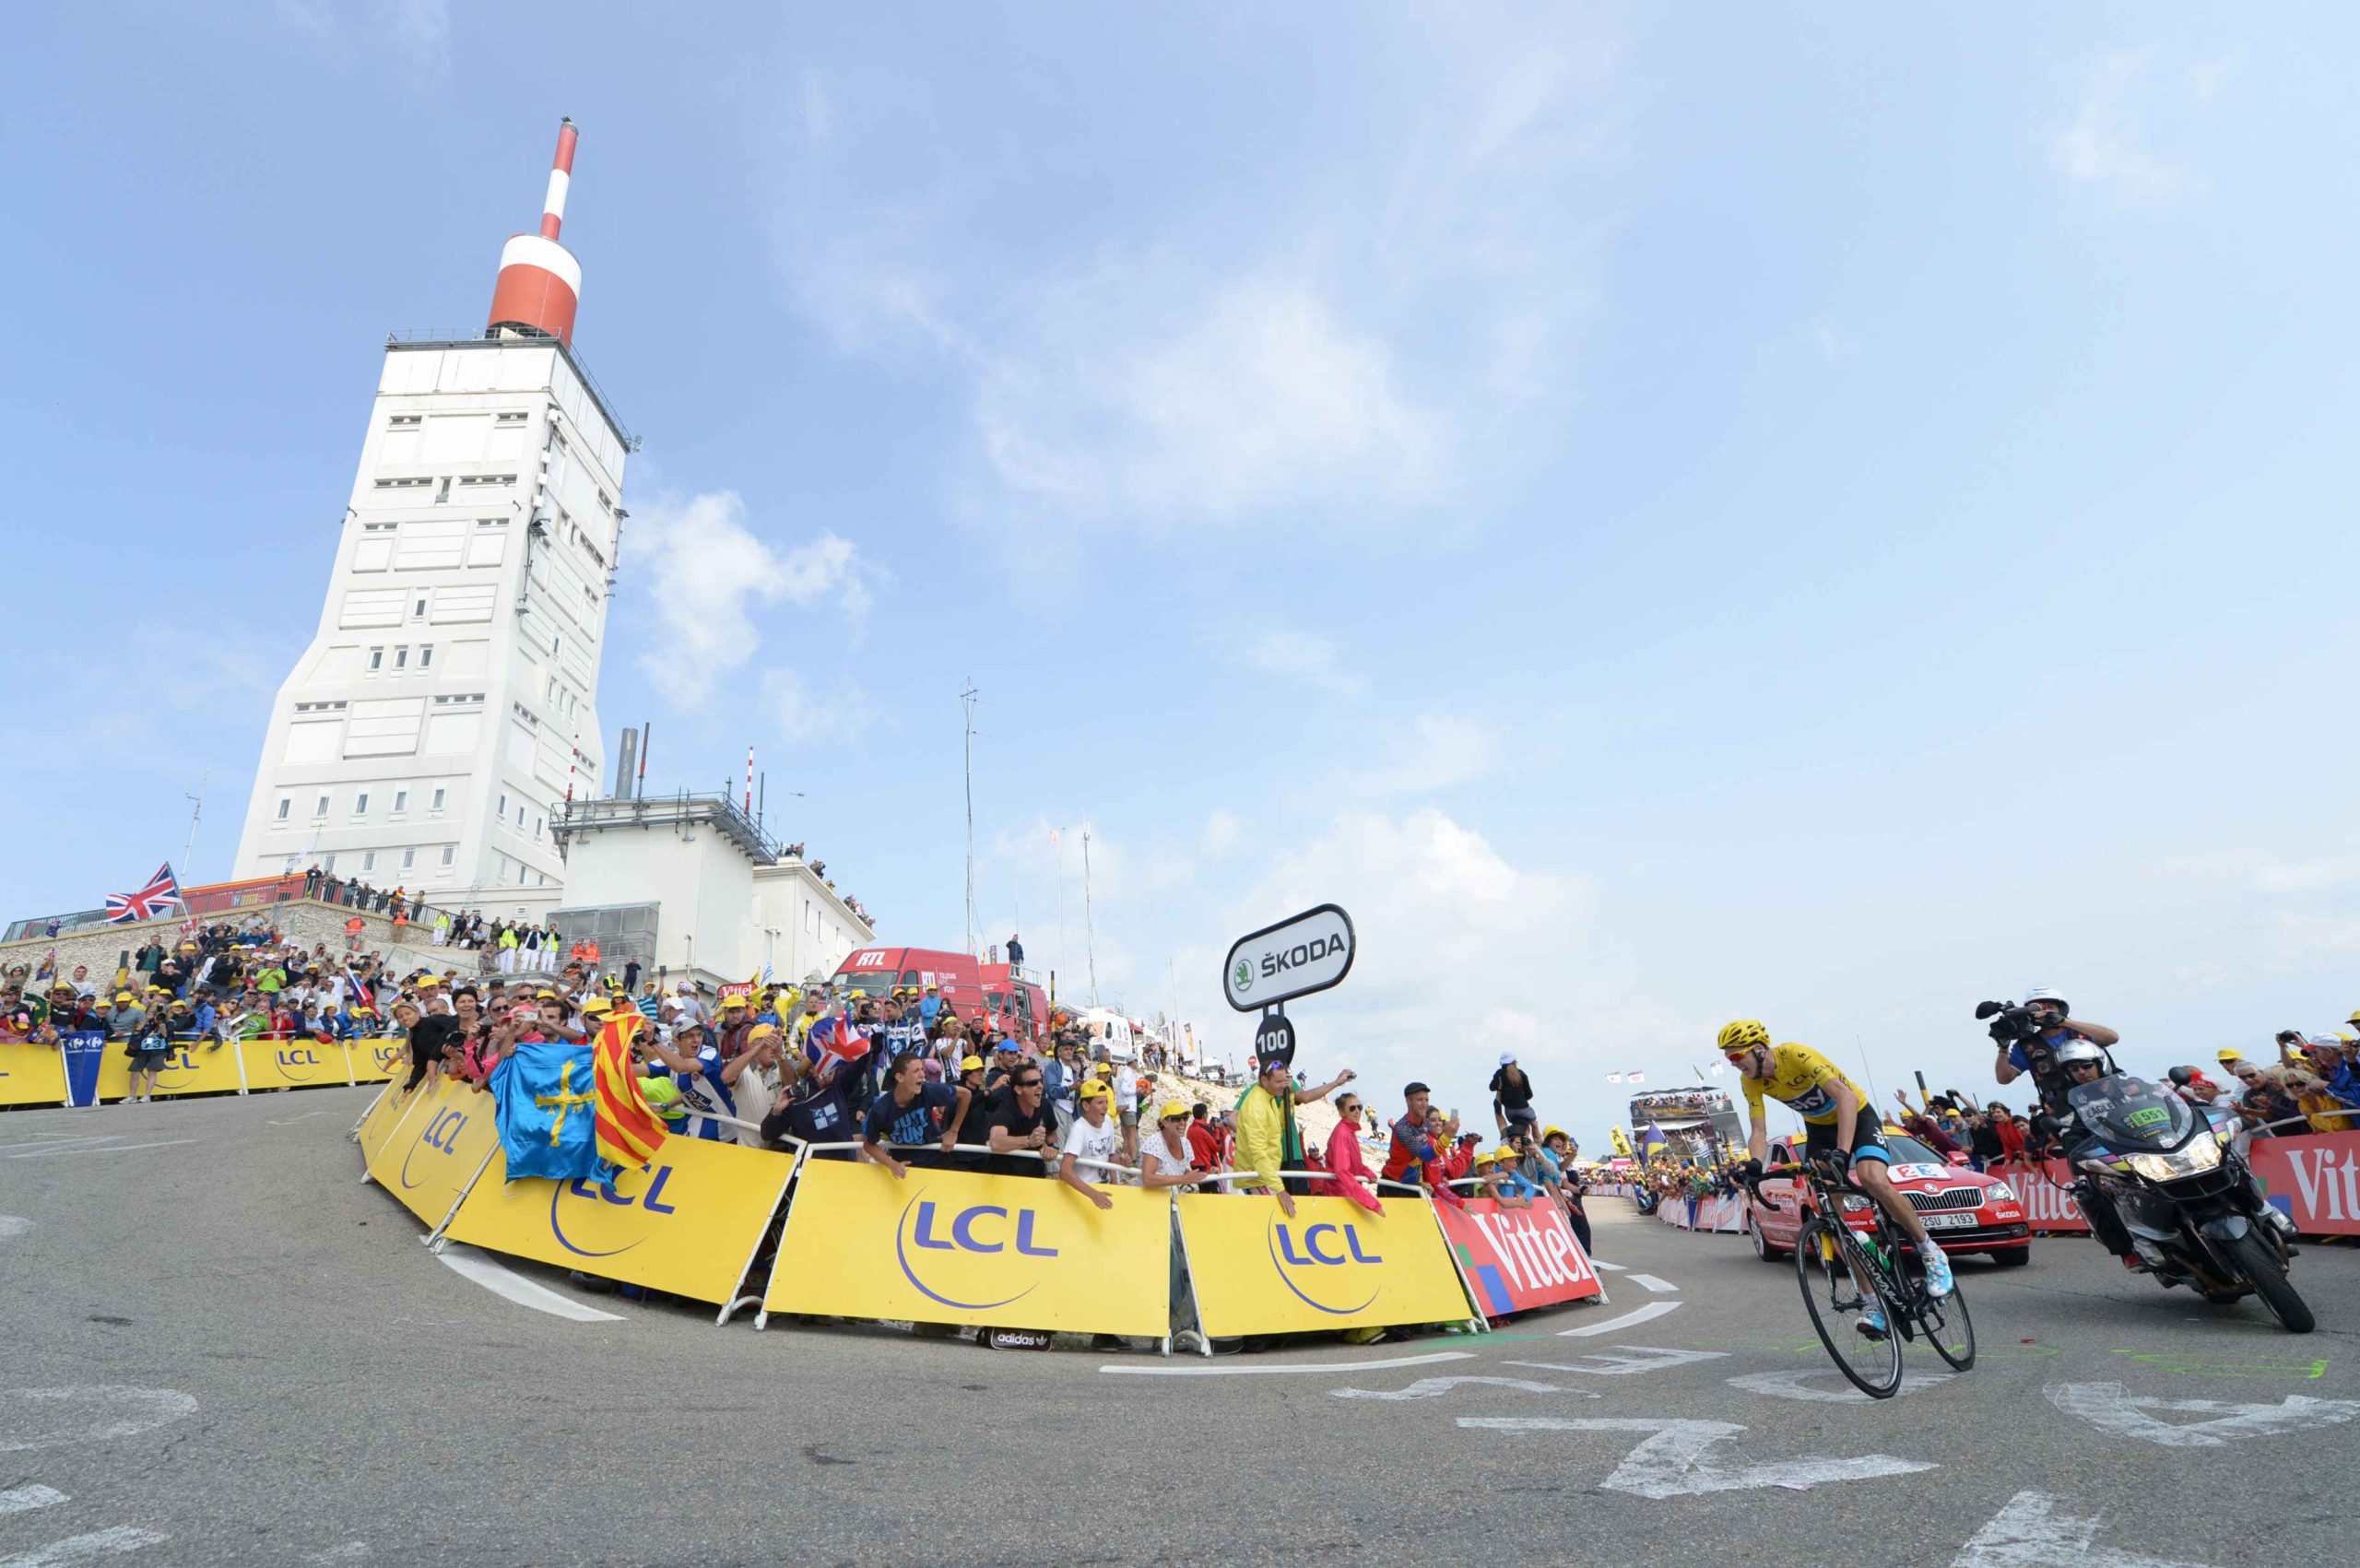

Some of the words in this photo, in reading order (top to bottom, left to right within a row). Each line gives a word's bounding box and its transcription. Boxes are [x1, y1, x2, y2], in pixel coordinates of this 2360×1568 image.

[856, 951, 886, 967] RTL
[1261, 933, 1346, 979] ŠKODA
[278, 1049, 320, 1066] LCL
[374, 1047, 400, 1061] LC
[1257, 1029, 1288, 1054] 100
[423, 1105, 469, 1156] LCL
[2007, 1170, 2083, 1221] Vitte
[914, 1200, 1059, 1257] LCL
[1948, 1214, 1973, 1225] 2193
[1276, 1222, 1384, 1266] LCL
[1471, 1209, 1593, 1293] Vittel
[997, 1333, 1034, 1346] adidas
